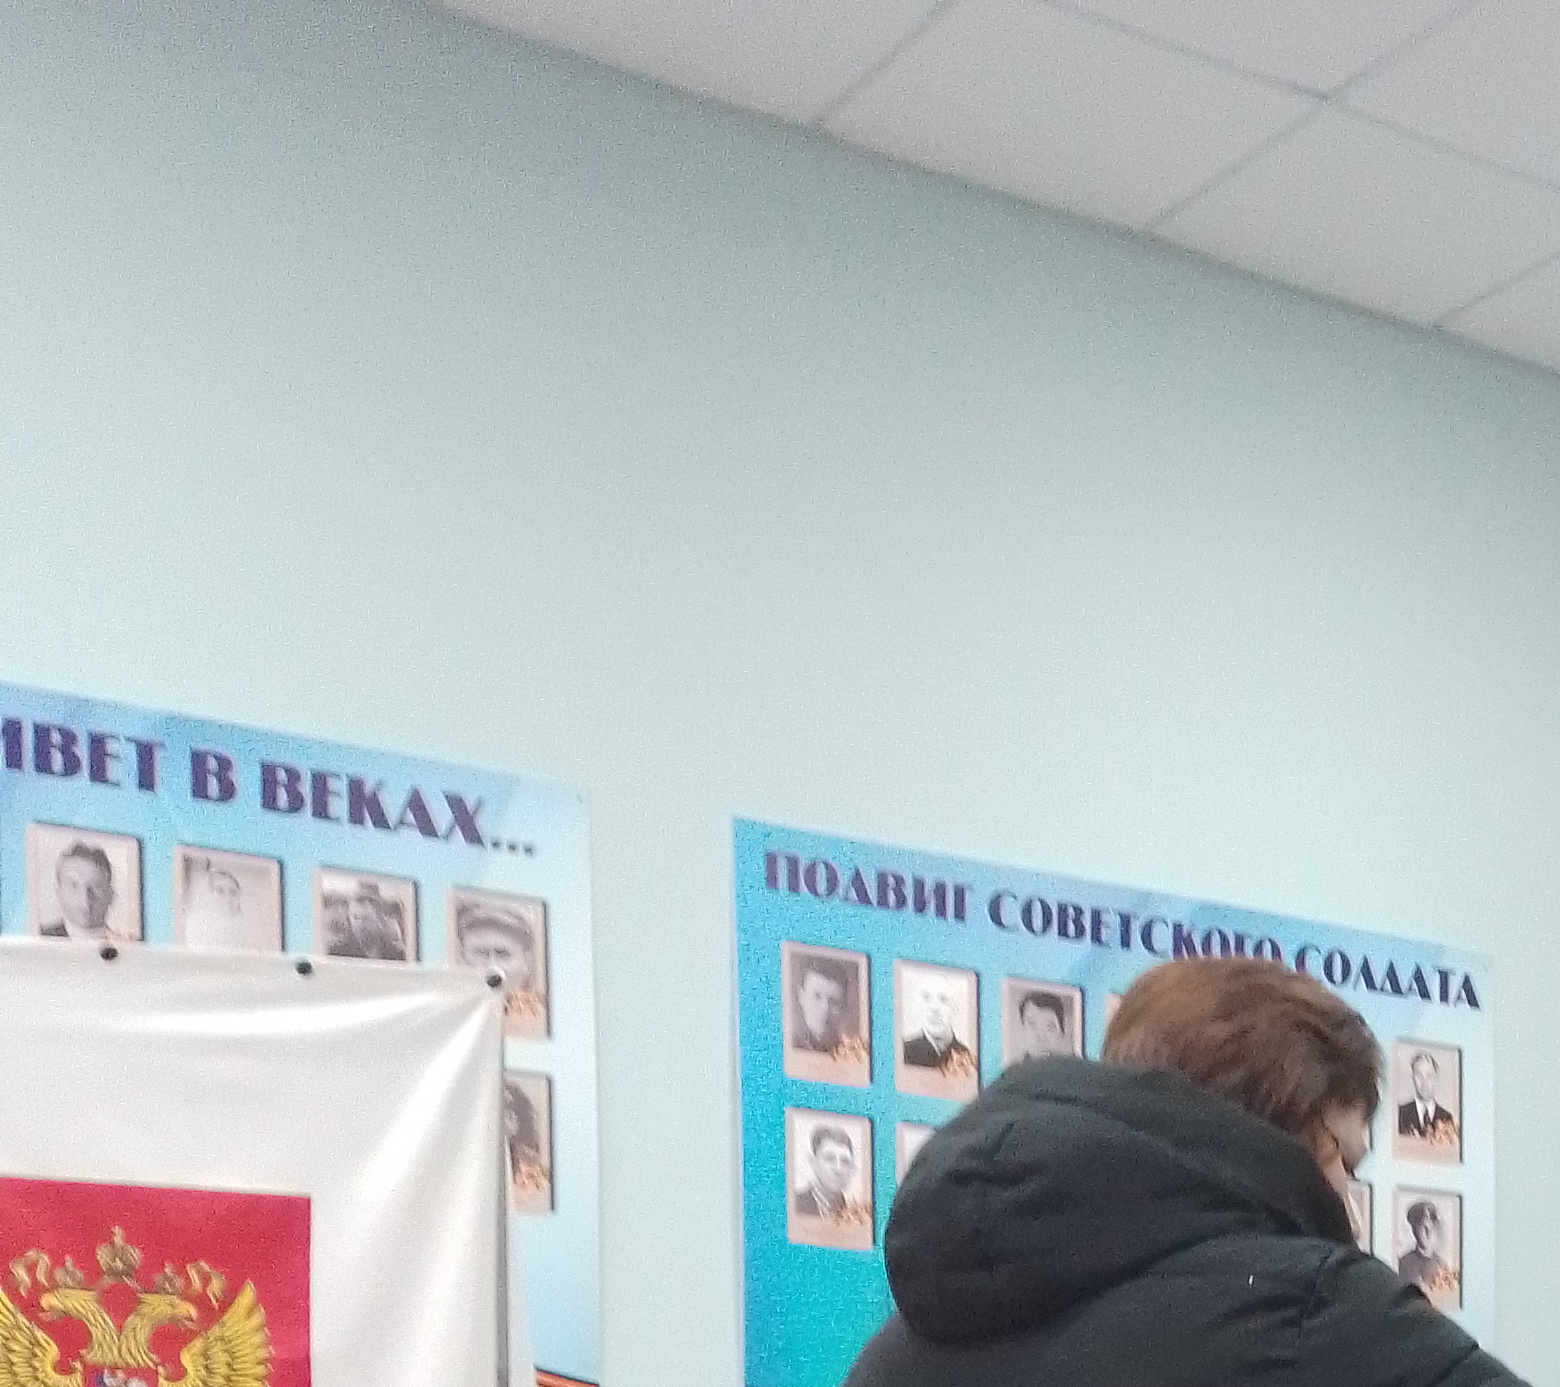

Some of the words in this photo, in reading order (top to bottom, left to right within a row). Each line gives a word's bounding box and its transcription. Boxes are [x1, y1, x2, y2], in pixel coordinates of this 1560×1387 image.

[189, 746, 240, 802] В
[765, 851, 972, 922] ПОДВИГ
[987, 889, 1284, 962] СОВЕТСКОГО
[1294, 943, 1482, 1012] СОЛДАТА
